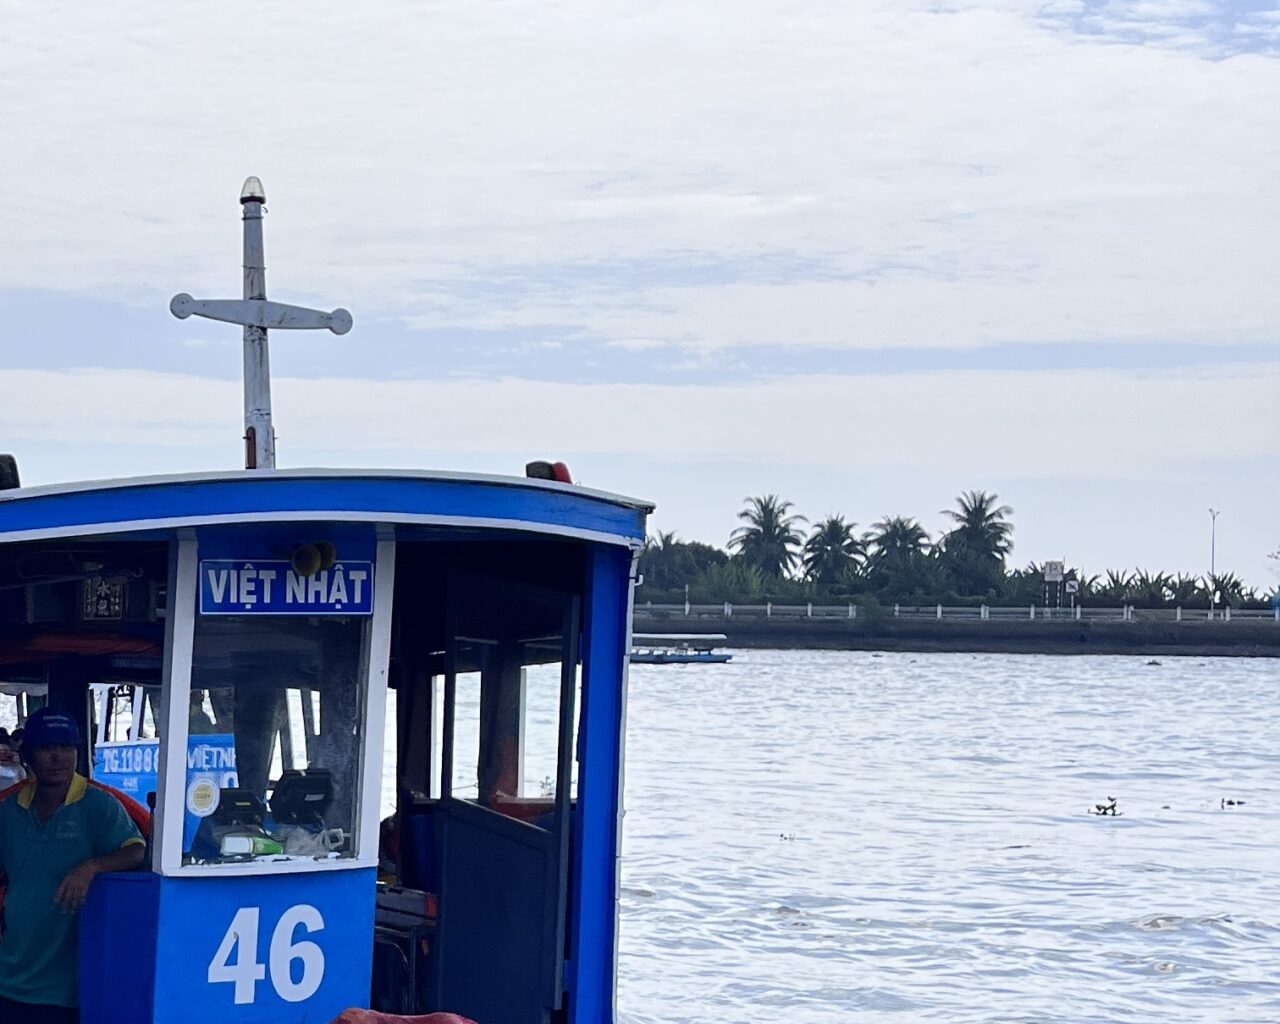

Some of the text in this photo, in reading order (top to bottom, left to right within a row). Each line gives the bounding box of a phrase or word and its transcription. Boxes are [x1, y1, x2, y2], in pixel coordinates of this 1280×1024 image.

[208, 563, 368, 609] VIỆT NHẬT
[208, 904, 325, 1004] 46
